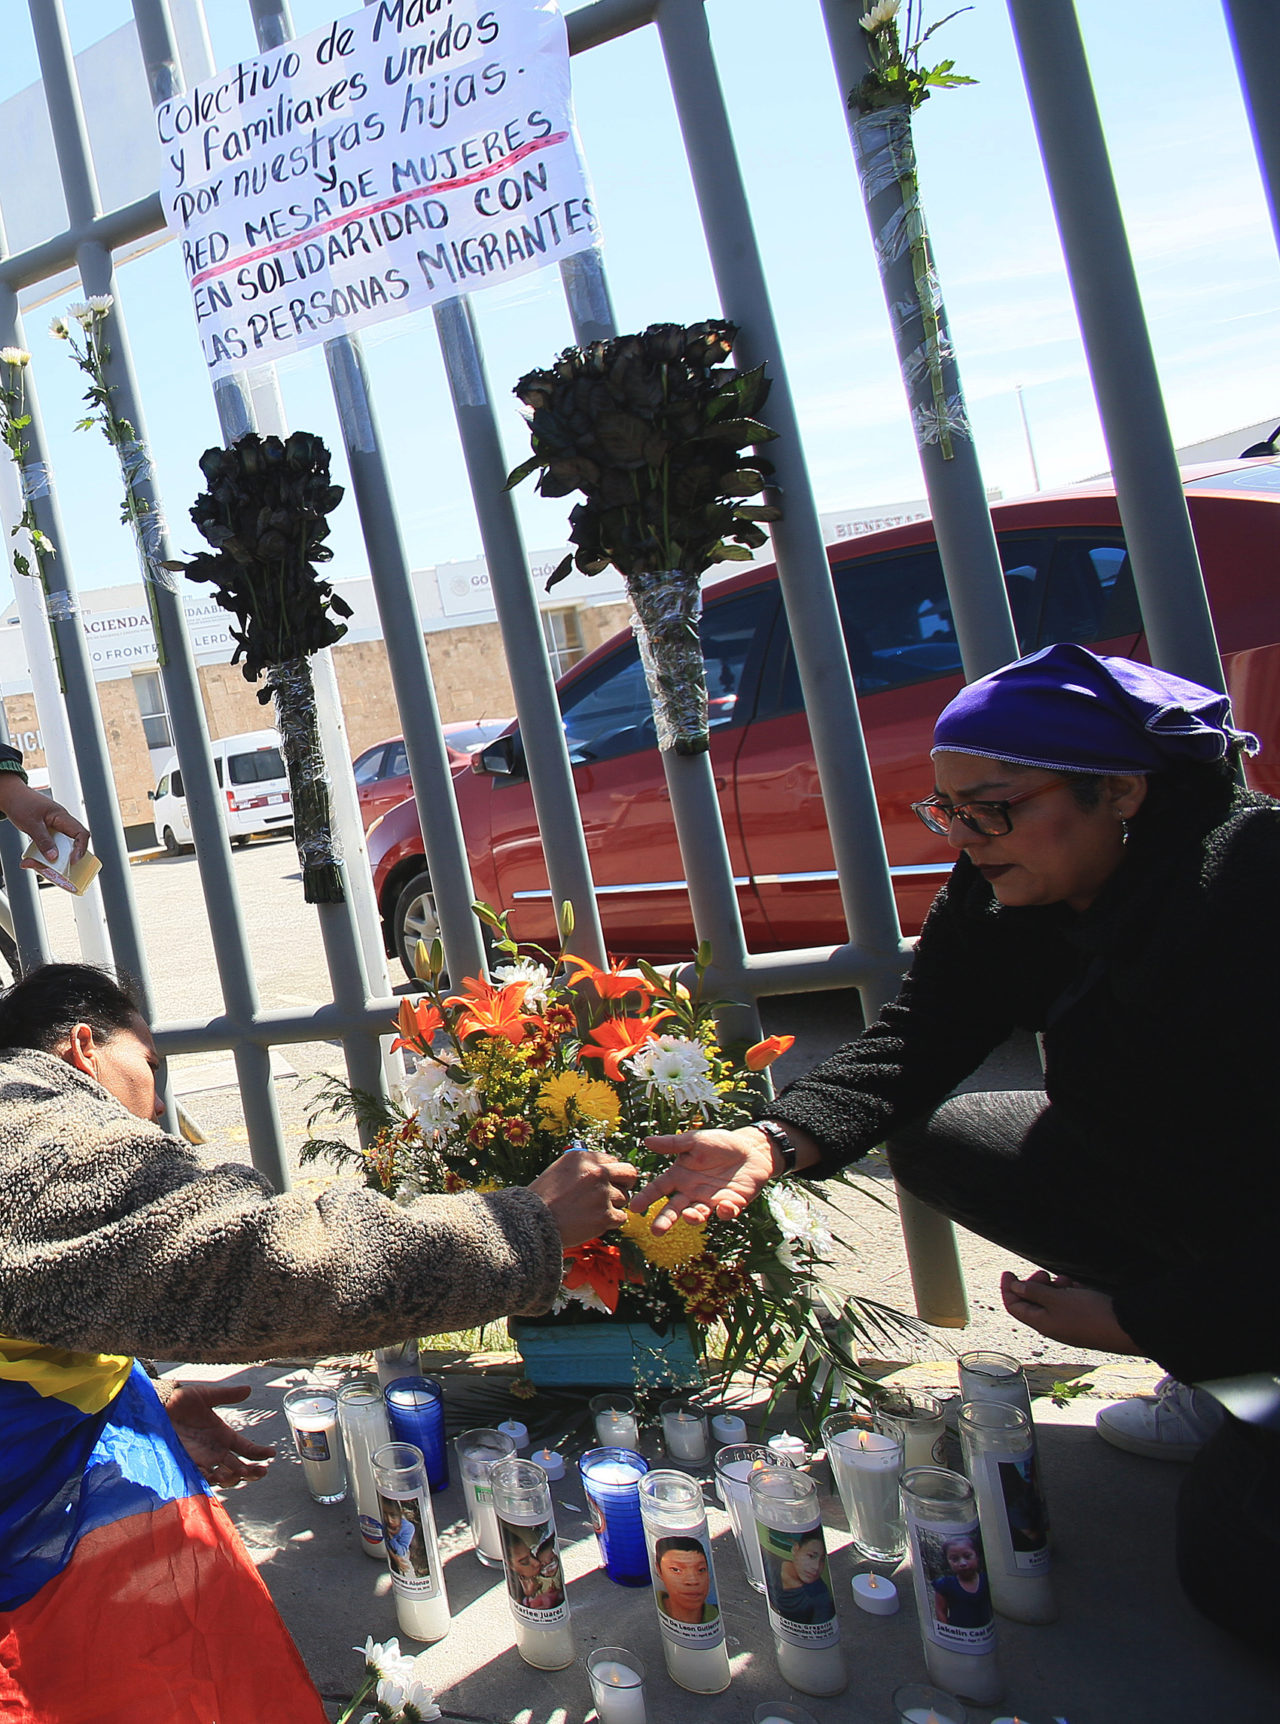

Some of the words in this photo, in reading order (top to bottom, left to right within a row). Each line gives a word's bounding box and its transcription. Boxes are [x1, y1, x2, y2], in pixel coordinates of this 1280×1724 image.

[157, 52, 301, 144] Colectivo
[316, 20, 356, 65] de
[169, 148, 186, 189] y
[172, 179, 223, 231] por
[233, 112, 385, 198] nuestras
[181, 230, 230, 276] RED
[244, 196, 352, 248] MESA
[339, 168, 378, 209] DE
[391, 110, 553, 194] MUJERES
[193, 280, 233, 325] EN
[237, 198, 450, 301] SOLIDARIDAD
[474, 162, 548, 217] CON
[200, 326, 248, 368] LAS
[246, 269, 411, 350] PERSONAS
[417, 198, 599, 291] MIGRANTES
